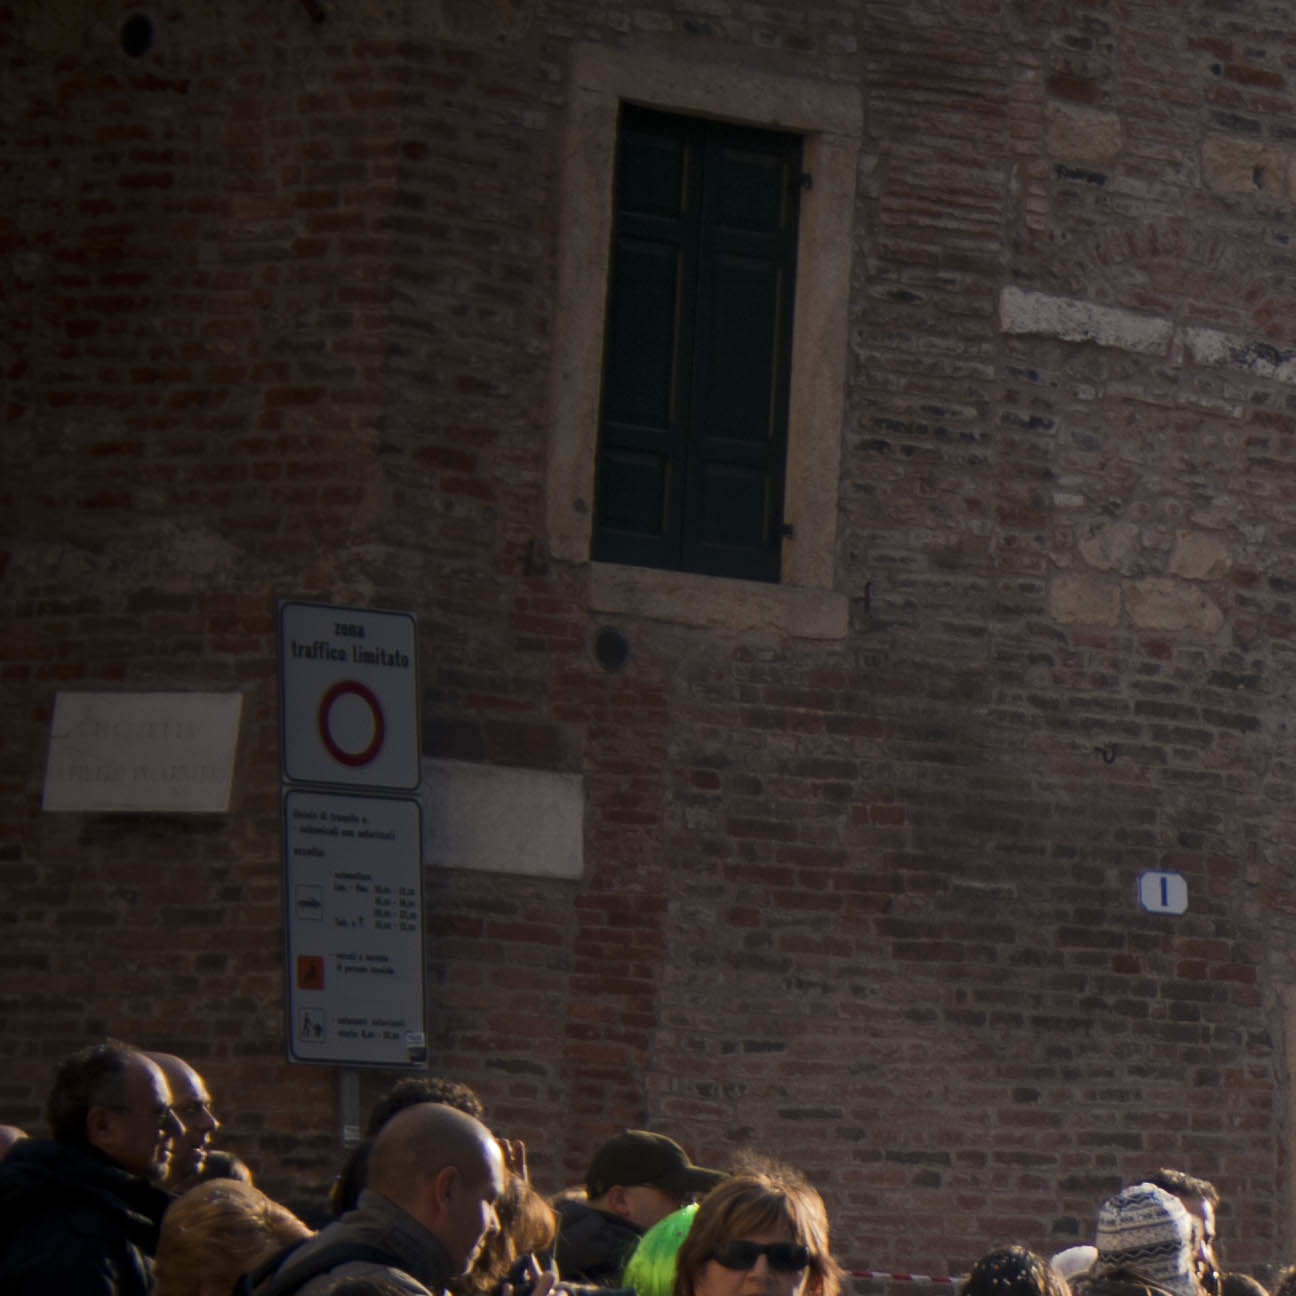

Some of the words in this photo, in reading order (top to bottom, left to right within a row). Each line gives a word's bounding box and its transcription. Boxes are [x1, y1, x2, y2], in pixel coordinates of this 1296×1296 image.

[335, 622, 366, 639] zona
[291, 639, 347, 662] traffico
[352, 644, 410, 668] limitato
